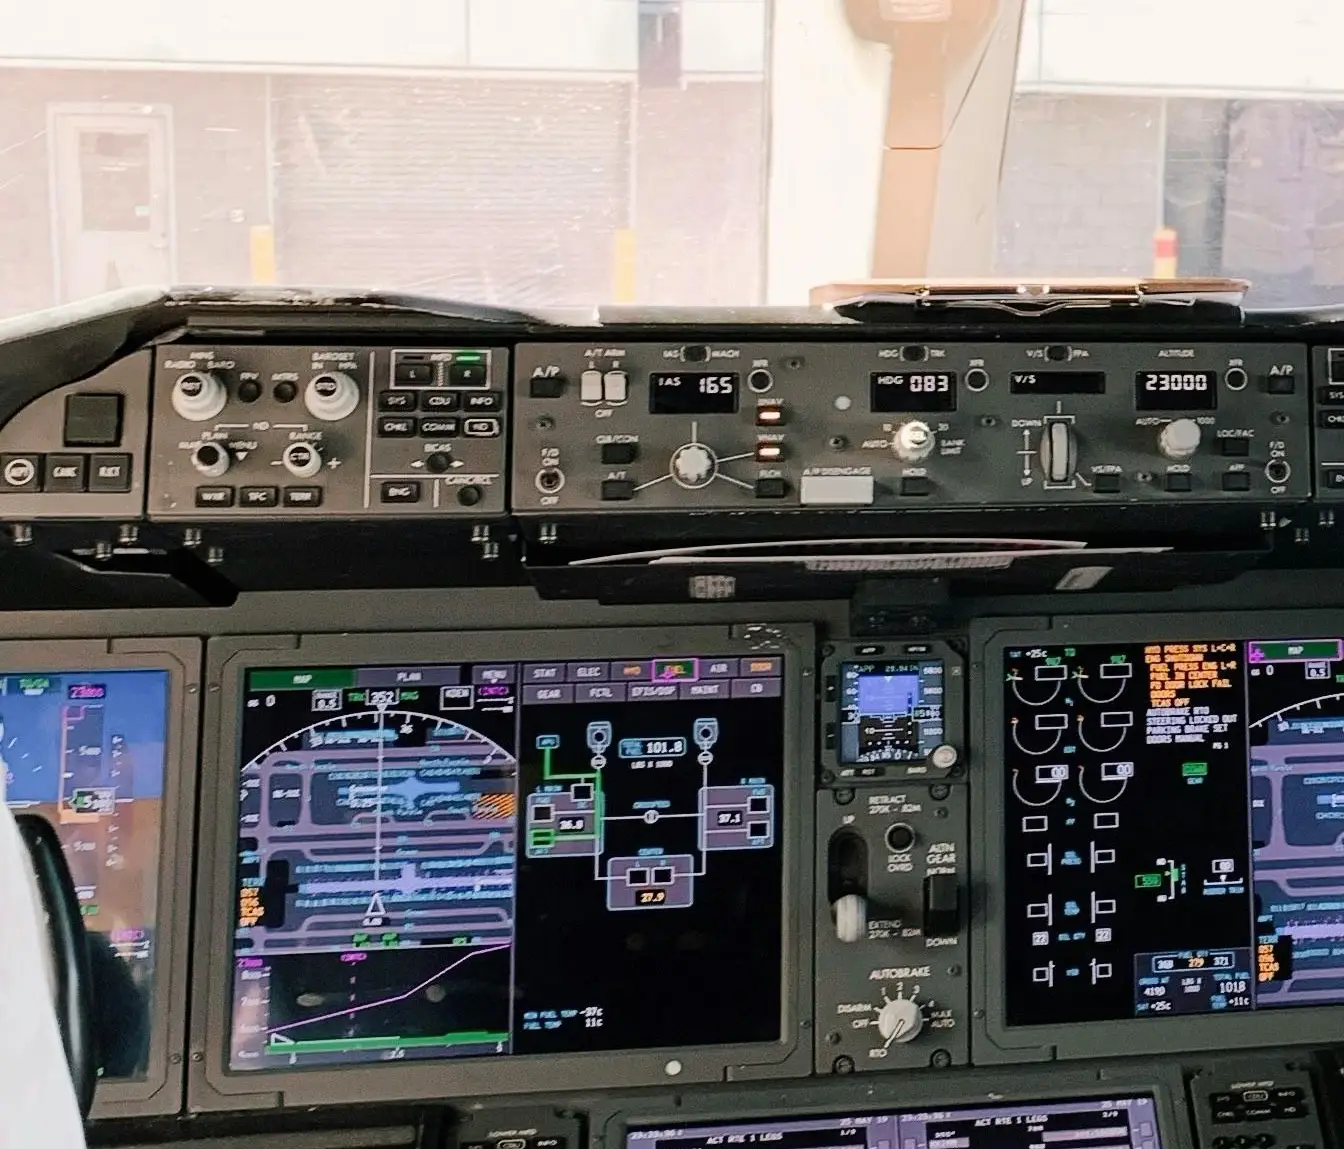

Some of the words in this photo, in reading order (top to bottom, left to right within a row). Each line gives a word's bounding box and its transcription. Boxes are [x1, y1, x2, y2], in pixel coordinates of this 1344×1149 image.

[533, 366, 559, 377] A/P
[1270, 365, 1293, 375] A/P
[877, 375, 904, 386] HDG
[910, 375, 949, 392] 083
[1015, 374, 1036, 385] V/S
[1146, 374, 1207, 391] 23000
[699, 376, 733, 394] 165
[1271, 486, 1286, 495] OFF
[869, 795, 906, 804] RETRACT
[843, 815, 855, 824] UP
[926, 853, 956, 864] GEAR
[868, 920, 901, 930] EXTEND
[926, 937, 957, 947] DOWN
[869, 966, 931, 980] AUTOBRAKE
[881, 987, 886, 995] 1
[897, 982, 903, 991] 2
[914, 985, 920, 994] 3
[837, 1003, 871, 1013] DISARM
[852, 1019, 869, 1028] OFF
[931, 1019, 955, 1028] AUTO
